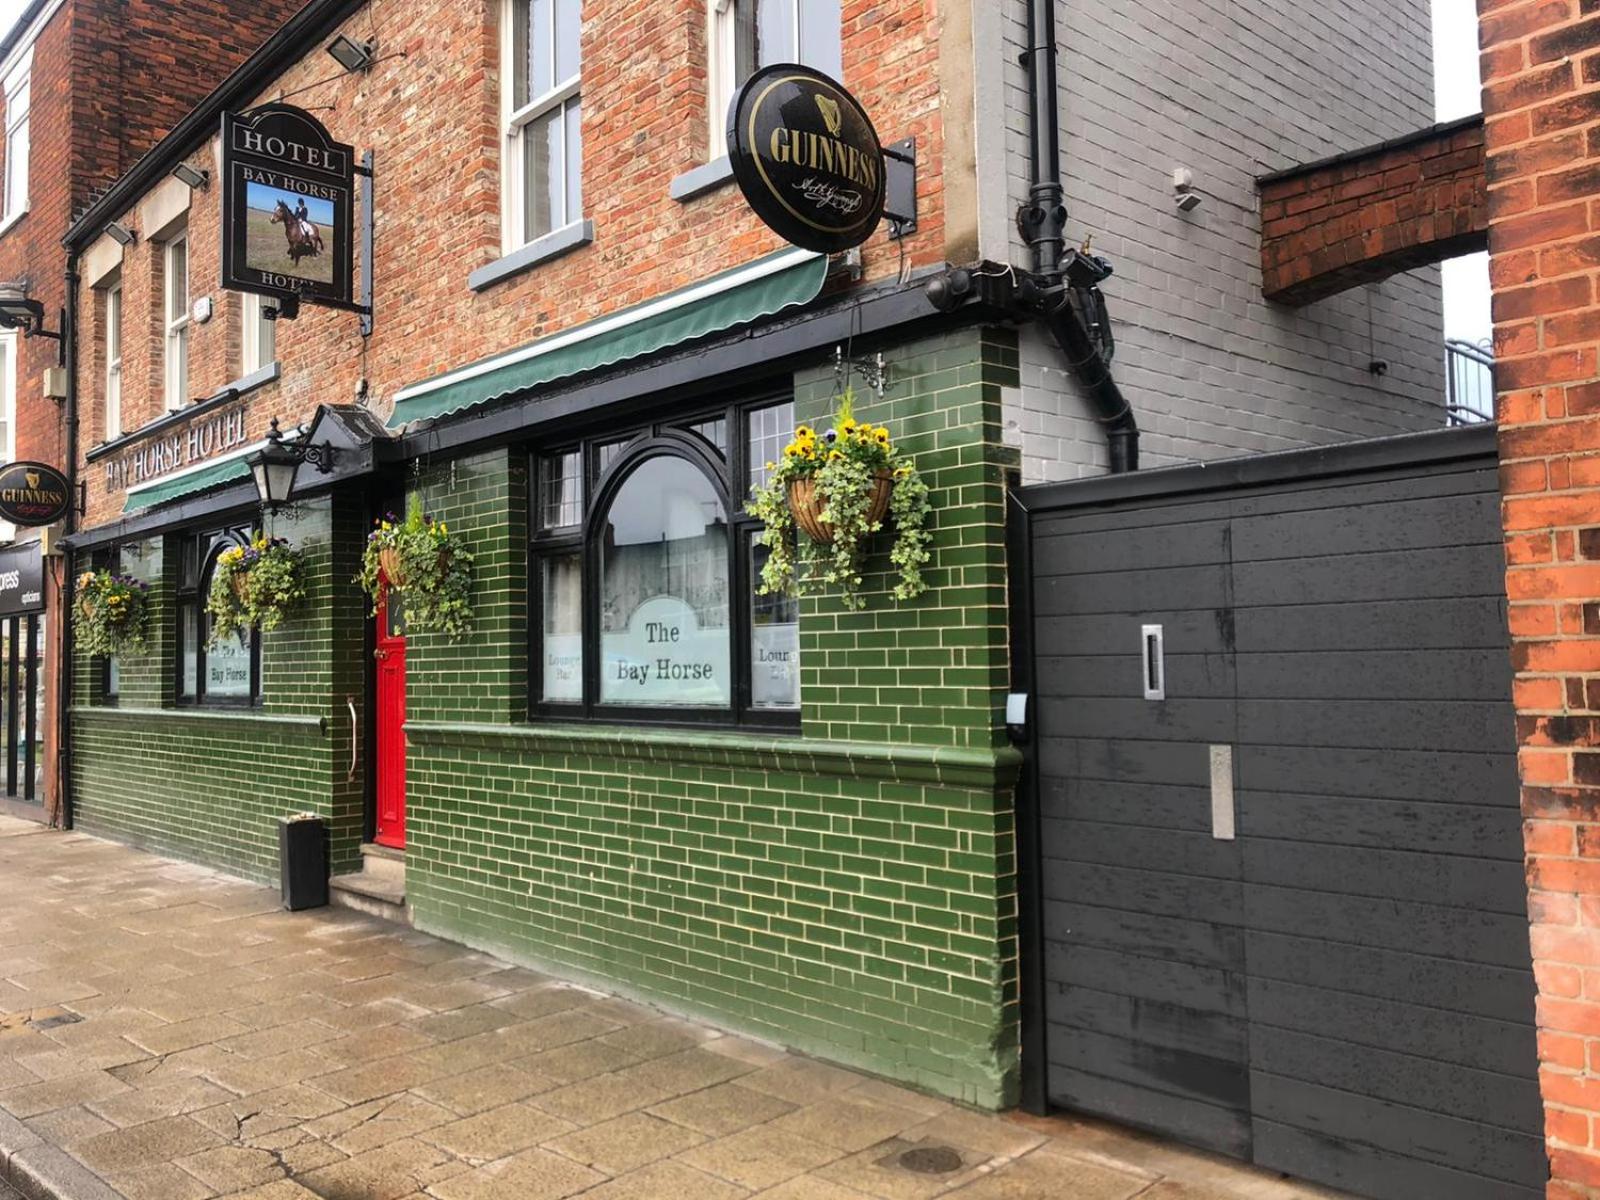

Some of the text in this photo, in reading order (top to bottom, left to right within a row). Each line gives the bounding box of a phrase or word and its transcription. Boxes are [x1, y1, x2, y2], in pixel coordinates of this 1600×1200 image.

[243, 130, 336, 170] HOTEL
[770, 127, 877, 191] GUINNESS
[243, 167, 338, 200] BAY HORSE
[261, 271, 314, 291] HOT
[106, 407, 246, 493] BAY HORSE HOTEL
[2, 488, 62, 504] GUINNESS
[646, 622, 680, 643] The
[617, 658, 713, 685] Bay Horse
